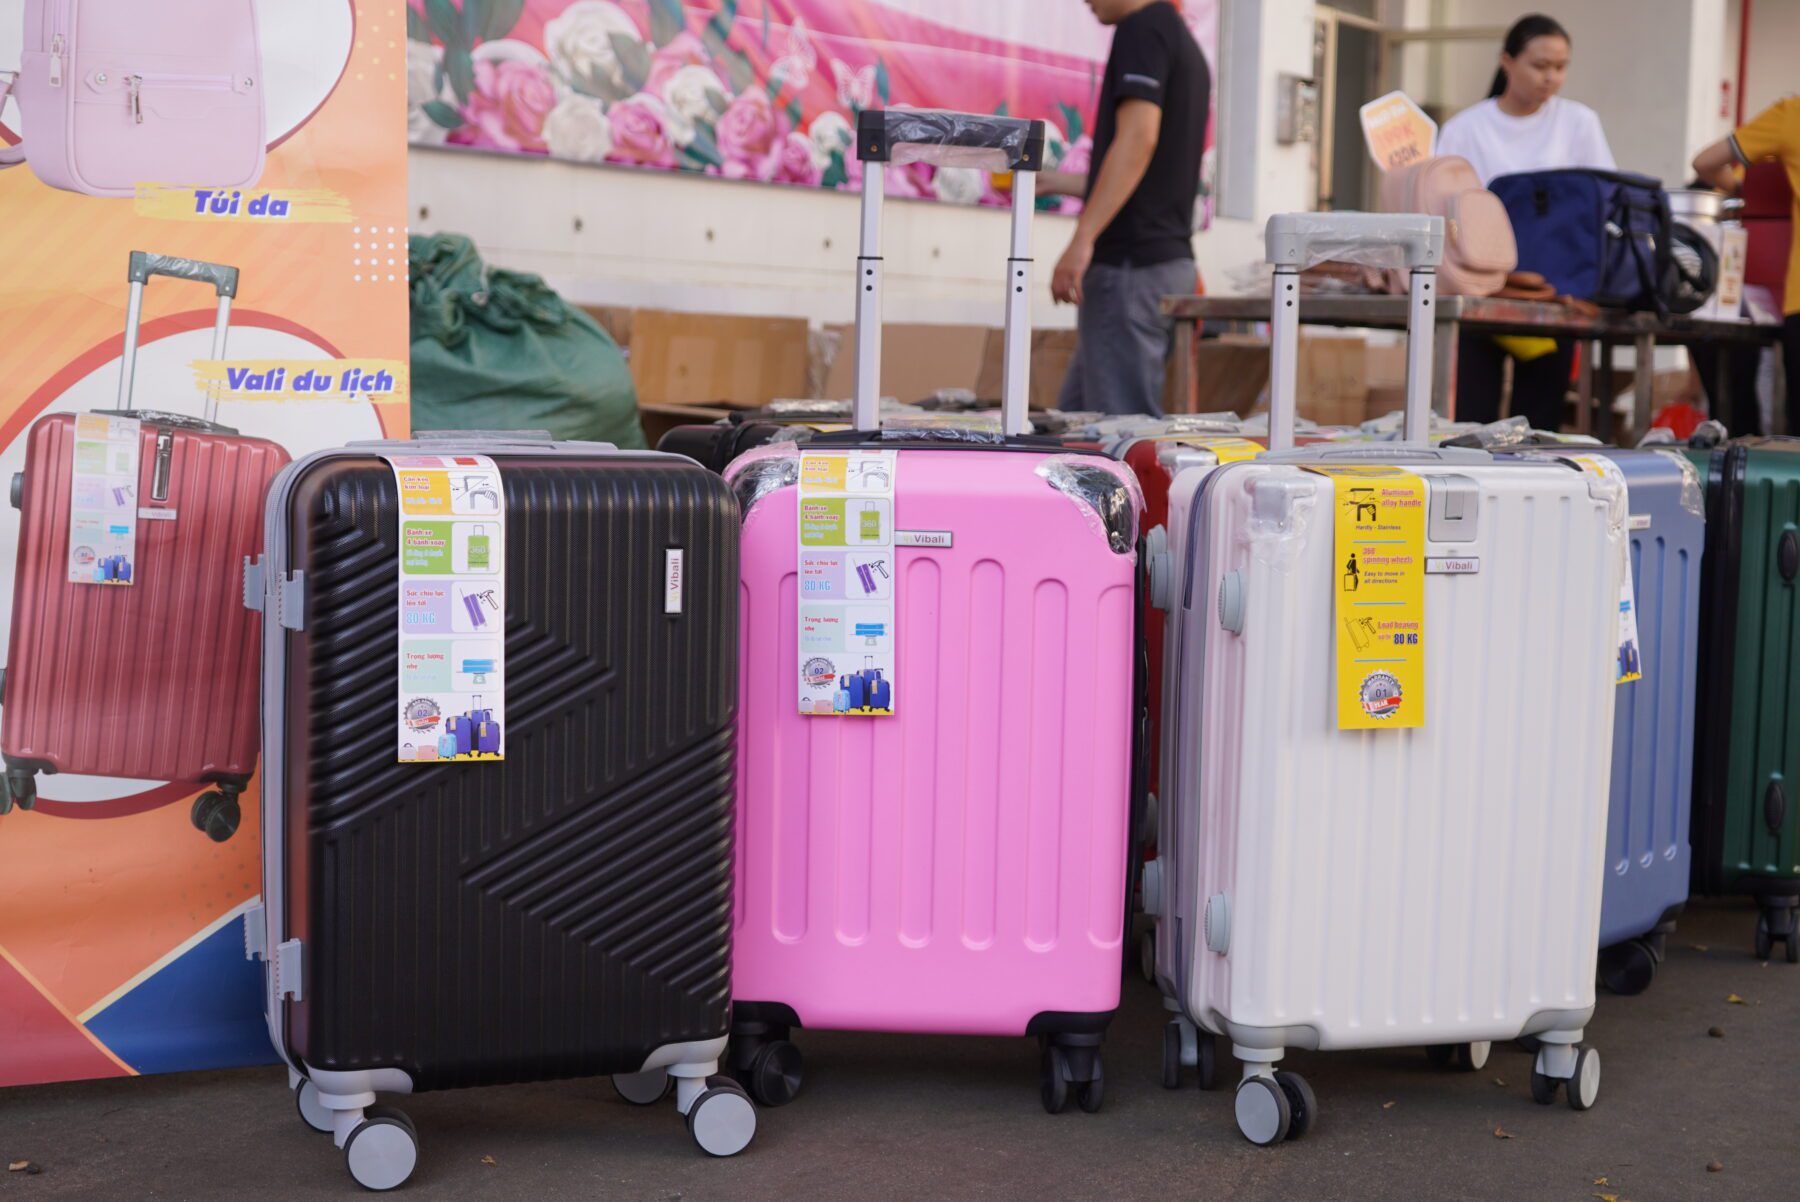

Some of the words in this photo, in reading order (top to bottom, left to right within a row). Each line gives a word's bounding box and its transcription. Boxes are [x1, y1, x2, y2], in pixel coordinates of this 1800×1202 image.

[194, 190, 241, 215] Túi
[247, 193, 289, 217] da
[226, 366, 286, 392] Vali
[292, 368, 332, 393] du
[339, 367, 394, 399] lịch
[1381, 499, 1398, 508] alloy
[1399, 499, 1422, 507] handle
[914, 534, 945, 544] Vibali
[1391, 555, 1414, 563] wheels
[1445, 561, 1473, 570] Vibali
[670, 558, 680, 590] Vibali
[804, 580, 816, 591] 80
[819, 580, 831, 591] KG
[406, 611, 419, 624] 80
[422, 611, 435, 624] KG
[1394, 621, 1419, 630] bearing
[1394, 633, 1405, 645] 80
[1406, 633, 1418, 645] KG
[814, 667, 824, 675] 02
[1375, 688, 1387, 698] 01
[416, 709, 428, 717] 02
